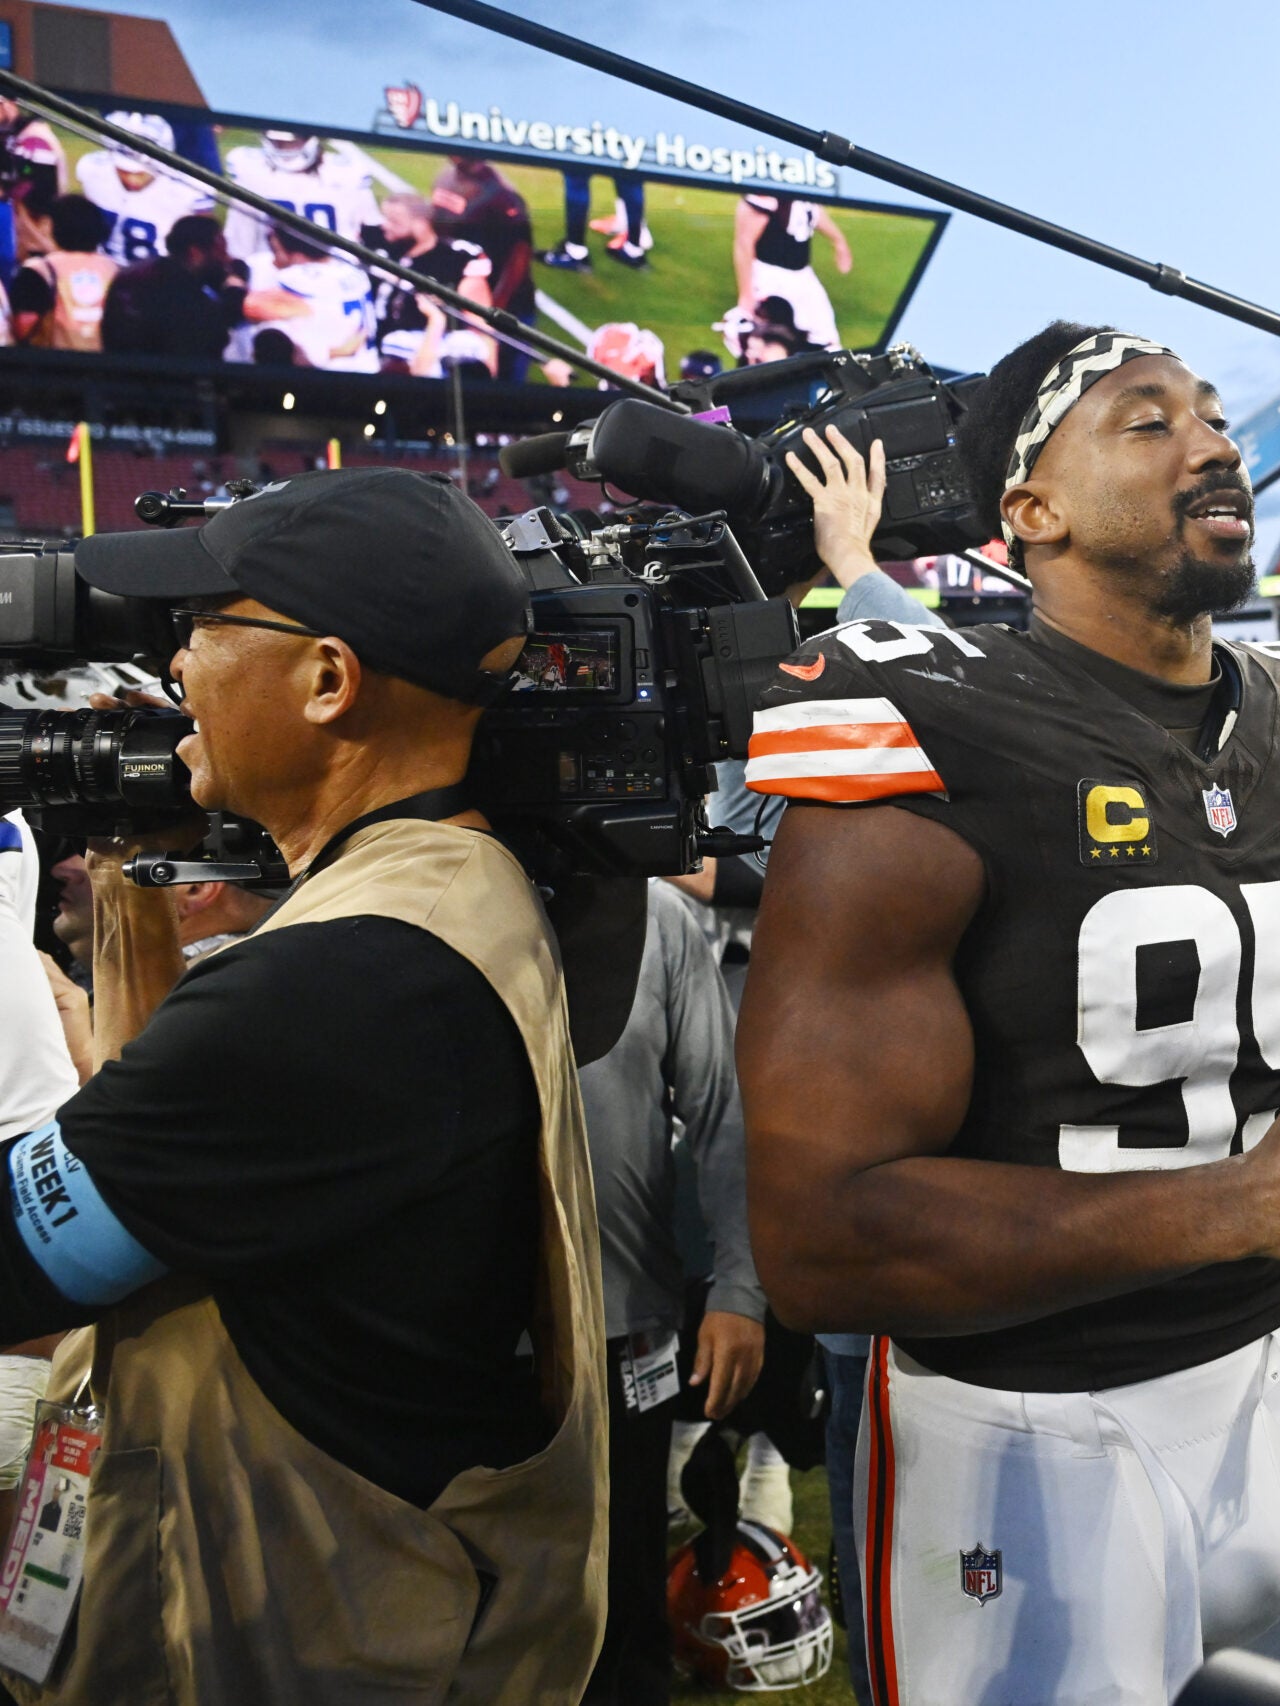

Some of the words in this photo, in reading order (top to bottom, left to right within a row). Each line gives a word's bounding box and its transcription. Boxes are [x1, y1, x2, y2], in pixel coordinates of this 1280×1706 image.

[425, 99, 646, 169] University
[656, 132, 837, 188] Hospitals
[125, 764, 165, 772] FUJINON
[1086, 785, 1150, 843] C
[1211, 808, 1233, 828] NFL
[30, 1132, 72, 1216] WEEK
[51, 1206, 79, 1229] 1
[63, 1151, 82, 1174] CLV
[18, 1177, 34, 1205] Field
[27, 1205, 52, 1244] Access
[966, 1570, 996, 1595] NFL
